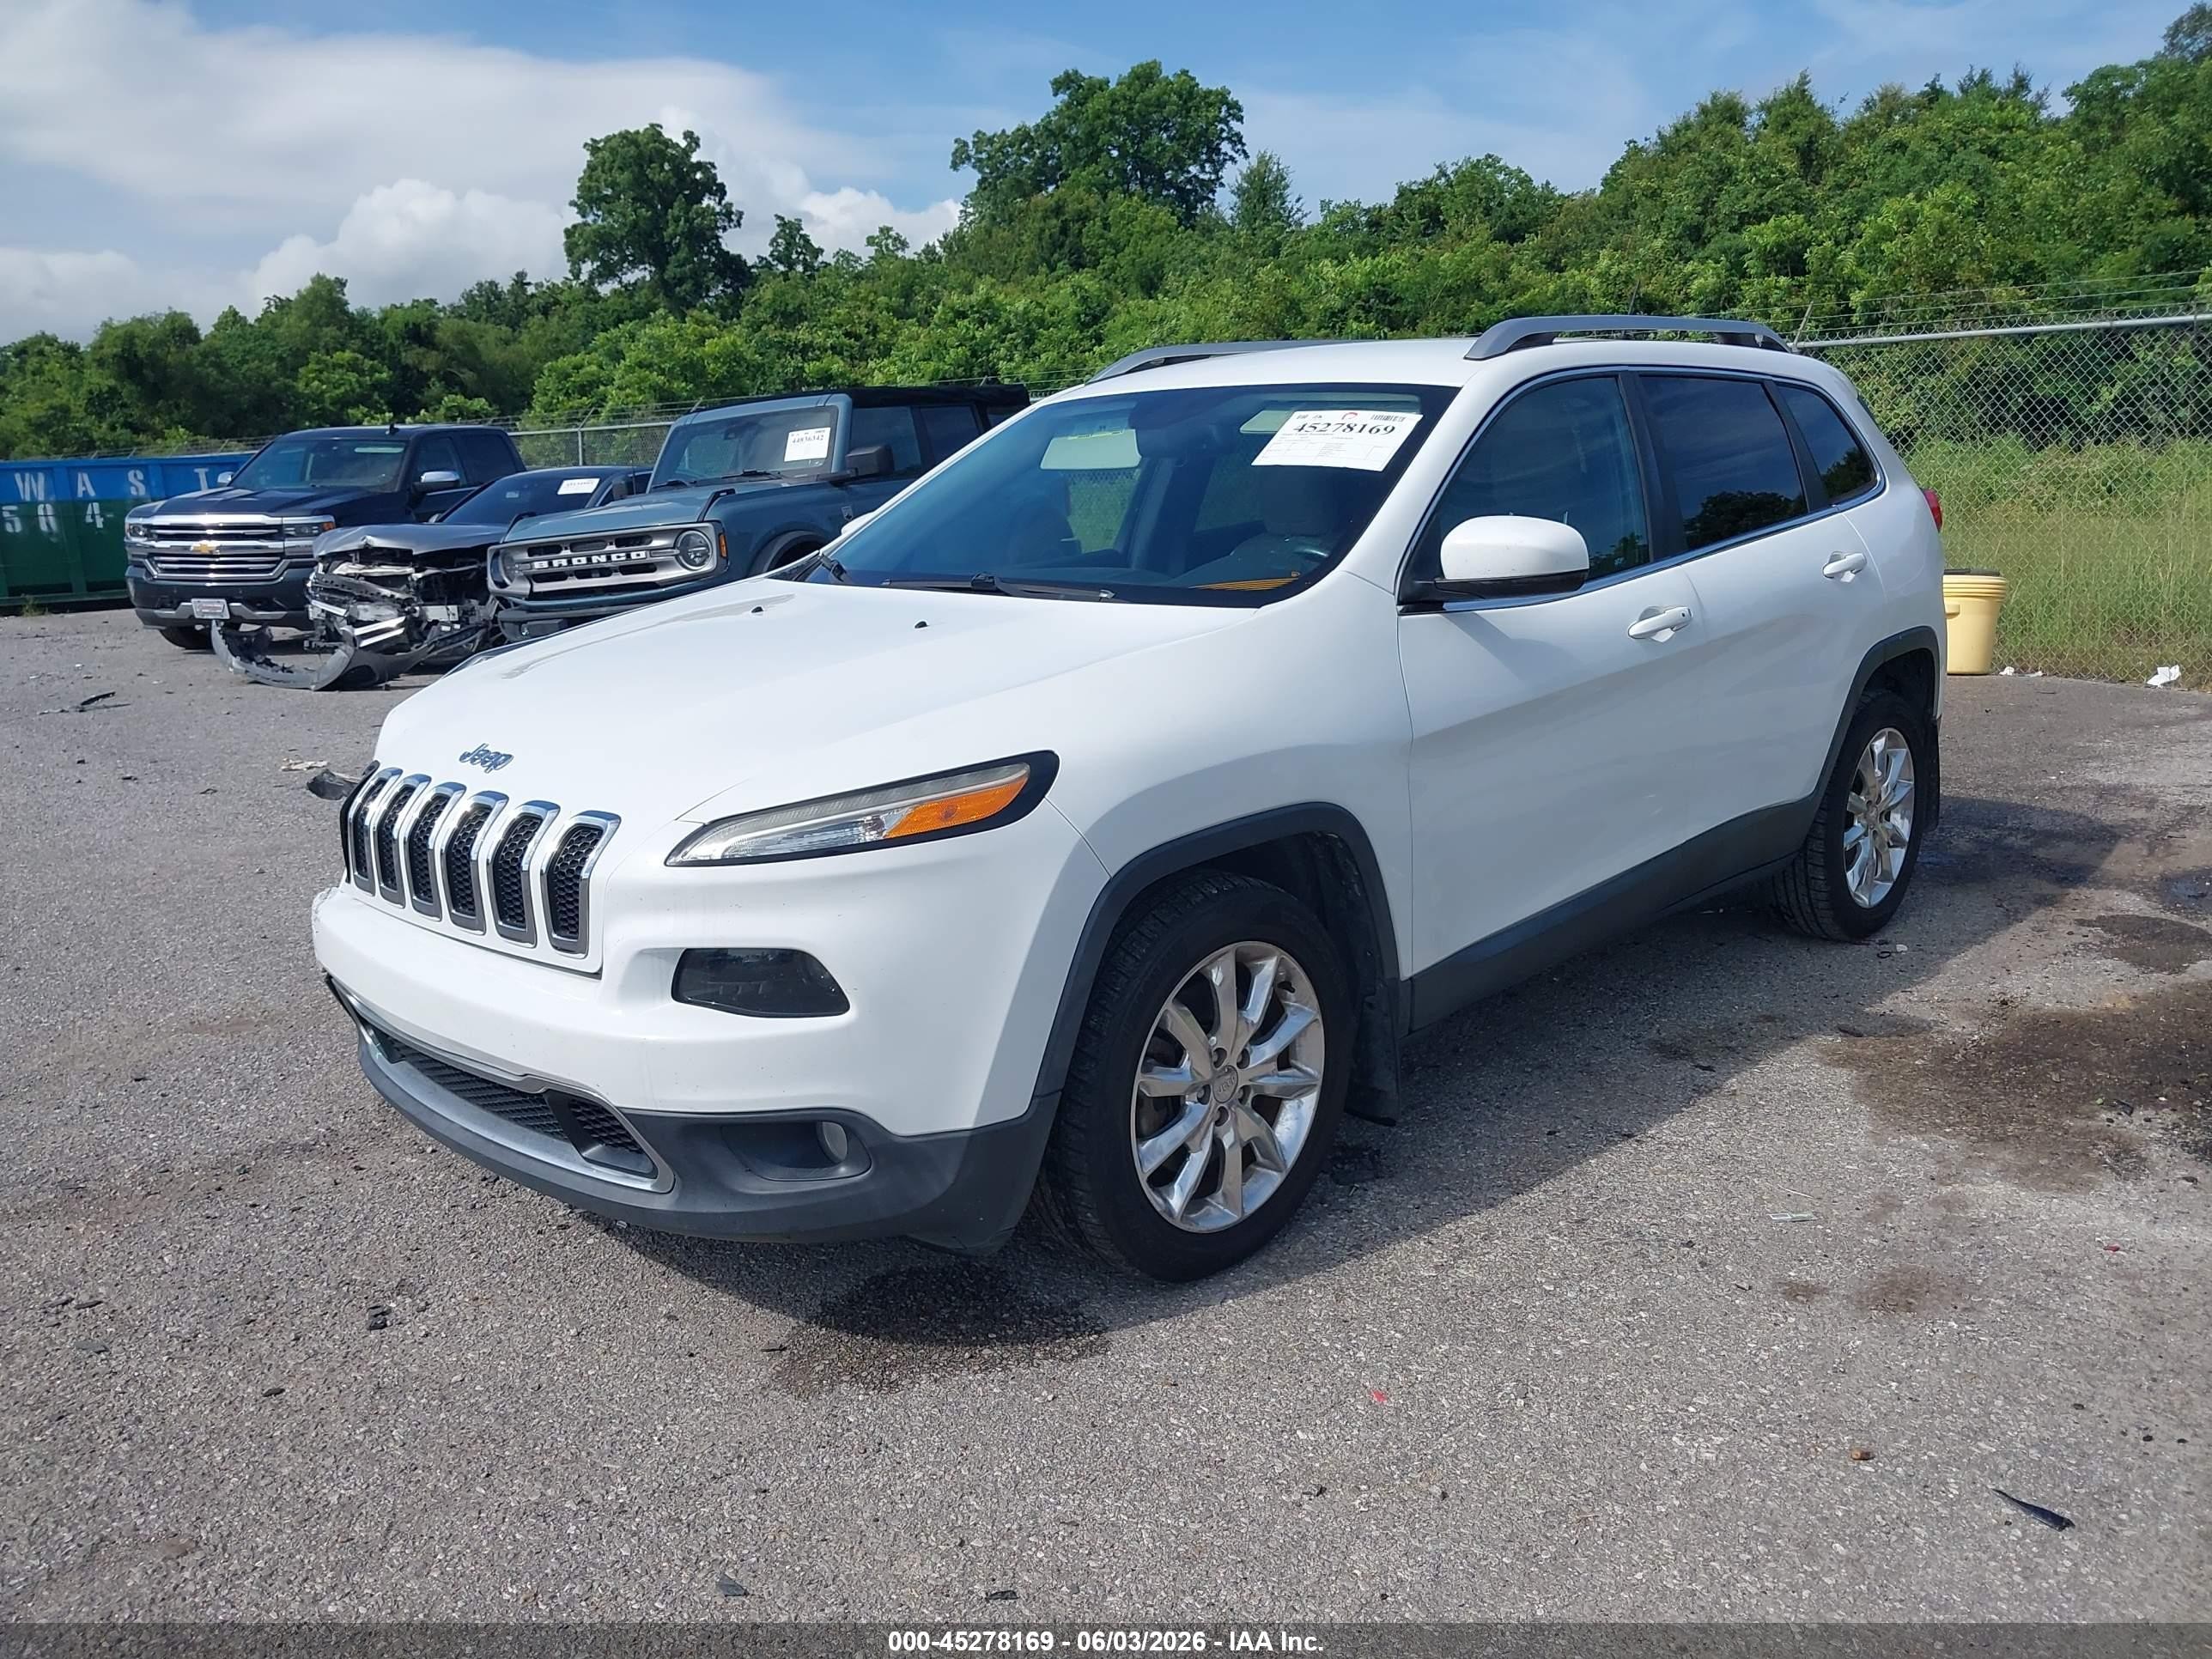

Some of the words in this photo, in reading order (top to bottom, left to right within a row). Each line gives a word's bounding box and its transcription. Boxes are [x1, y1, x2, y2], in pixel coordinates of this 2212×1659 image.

[1293, 422, 1395, 436] 45278169
[534, 550, 647, 569] BRONCO
[459, 743, 514, 774] Jeep
